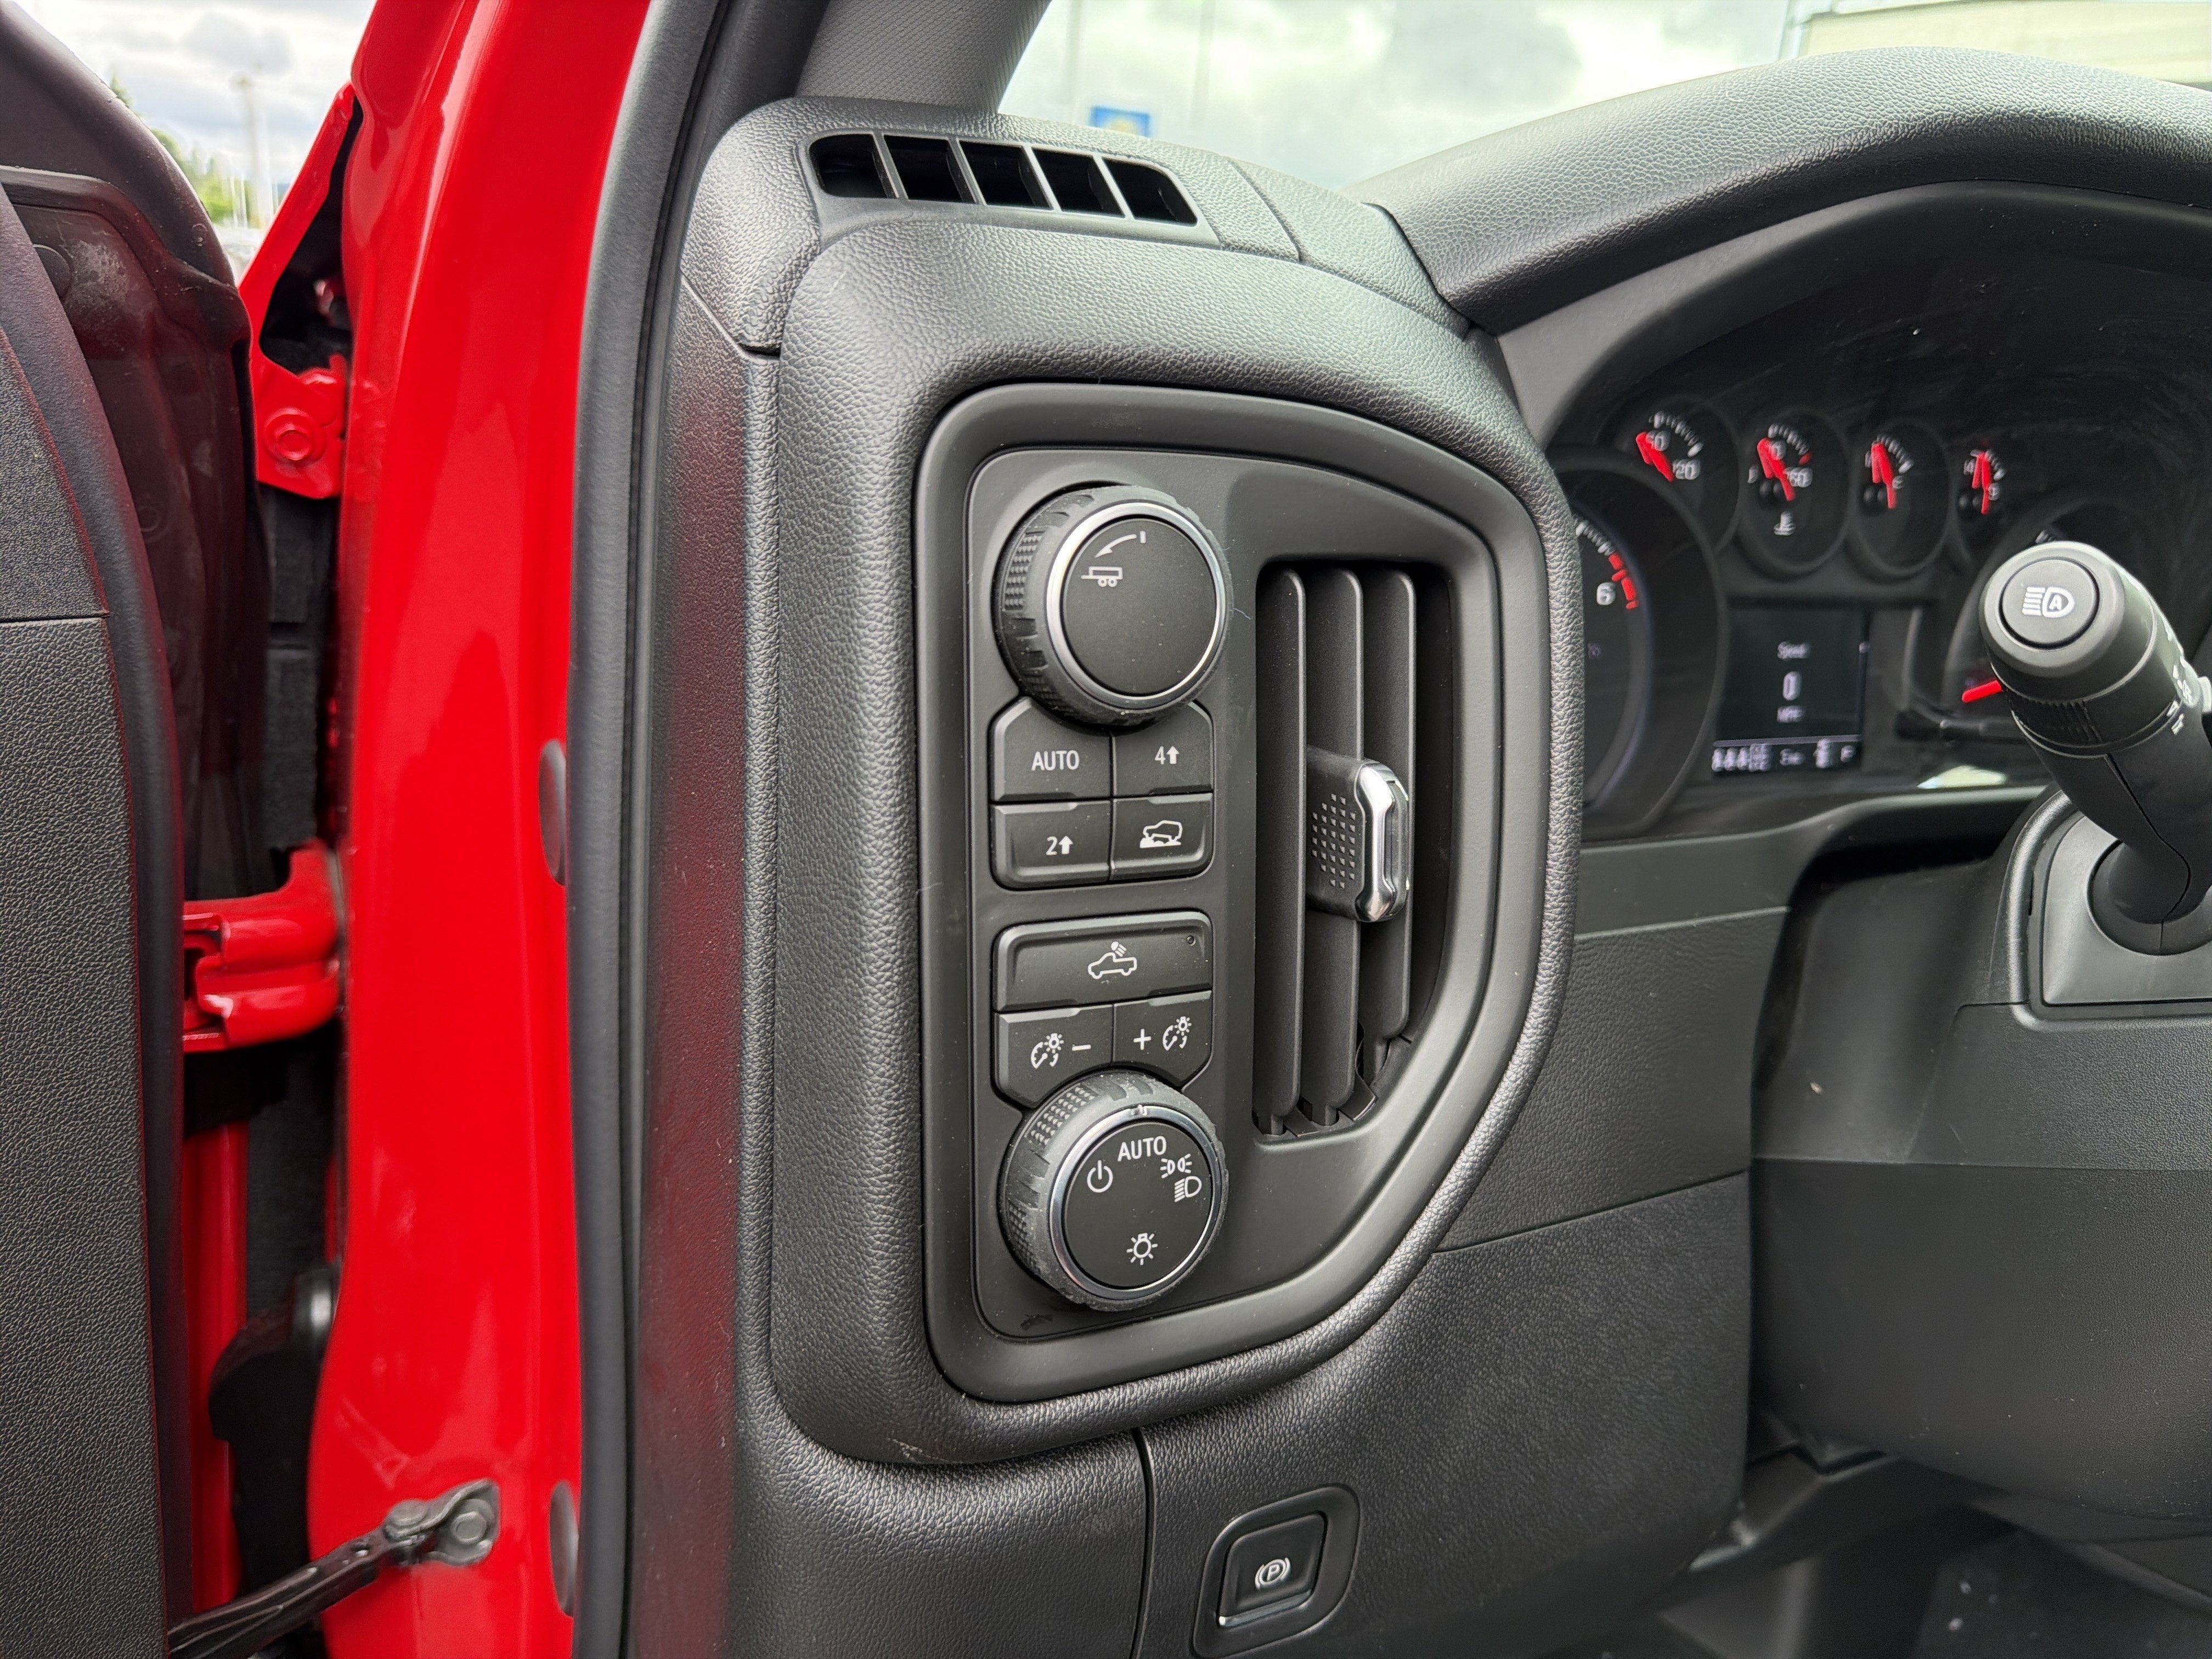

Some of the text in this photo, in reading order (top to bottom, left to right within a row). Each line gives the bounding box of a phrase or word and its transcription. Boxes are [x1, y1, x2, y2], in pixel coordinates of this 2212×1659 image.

[1031, 750, 1080, 771] AUTO
[1155, 746, 1166, 765] 4
[1046, 836, 1057, 855] 2
[1117, 1136, 1167, 1162] AUTO
